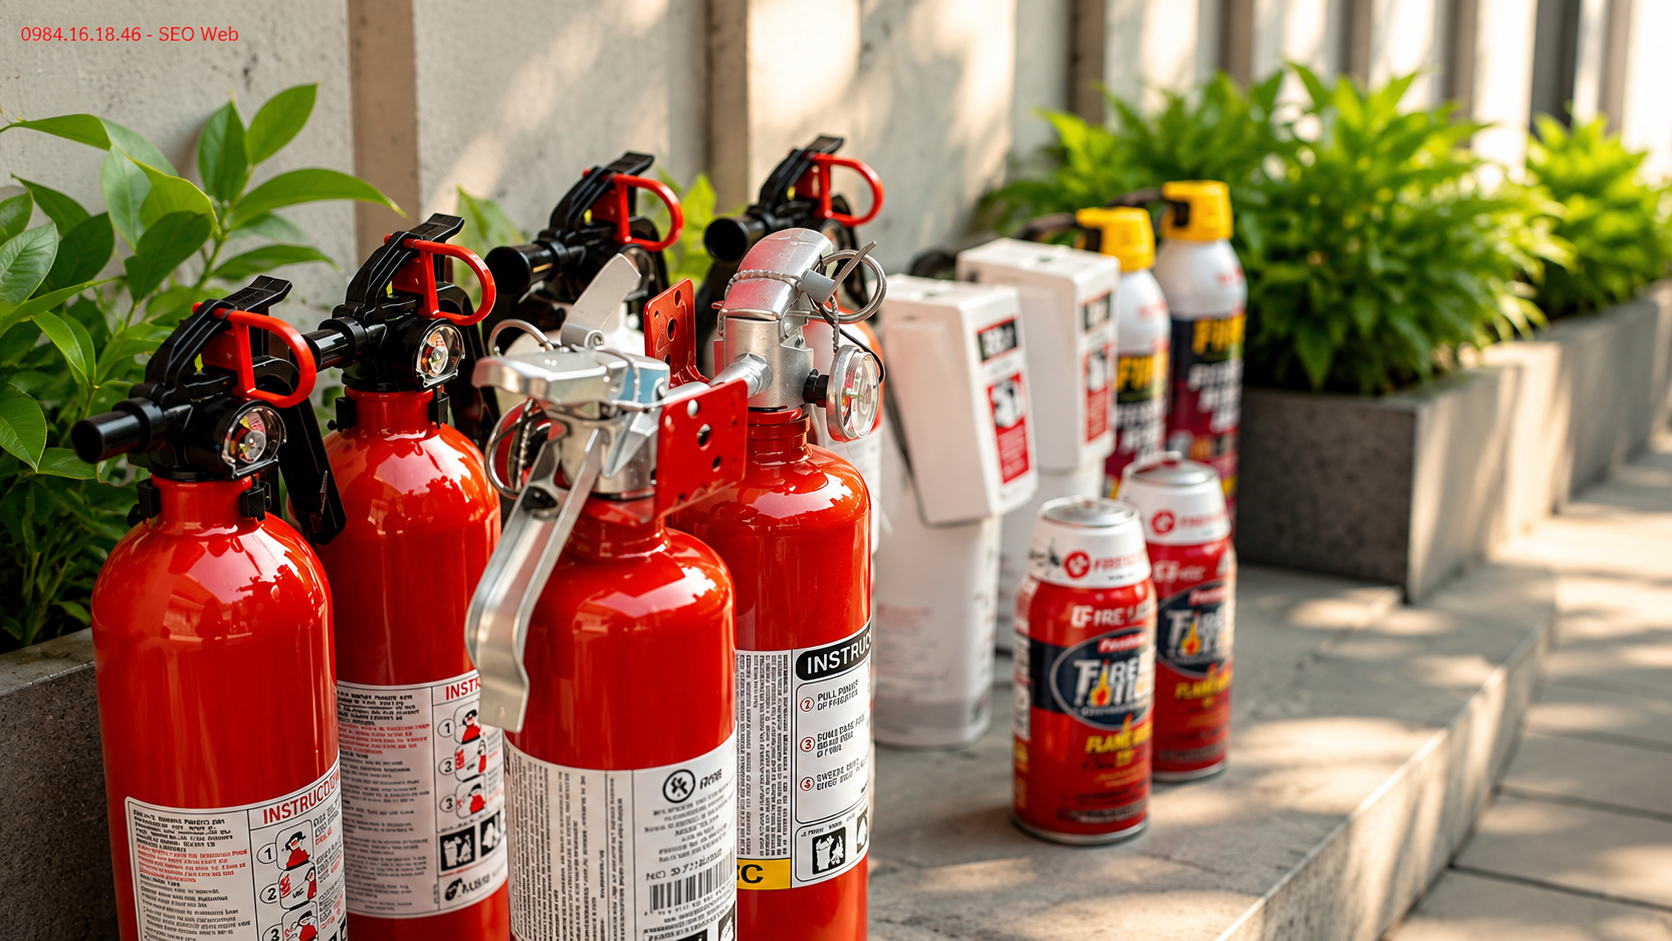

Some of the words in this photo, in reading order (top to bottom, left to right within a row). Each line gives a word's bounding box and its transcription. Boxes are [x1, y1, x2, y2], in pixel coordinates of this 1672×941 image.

[444, 722, 450, 734] 1
[805, 739, 812, 750] 3
[445, 797, 453, 810] 3
[264, 847, 273, 861] 1
[737, 864, 764, 884] C
[267, 888, 277, 901] 2
[271, 928, 280, 941] 3
